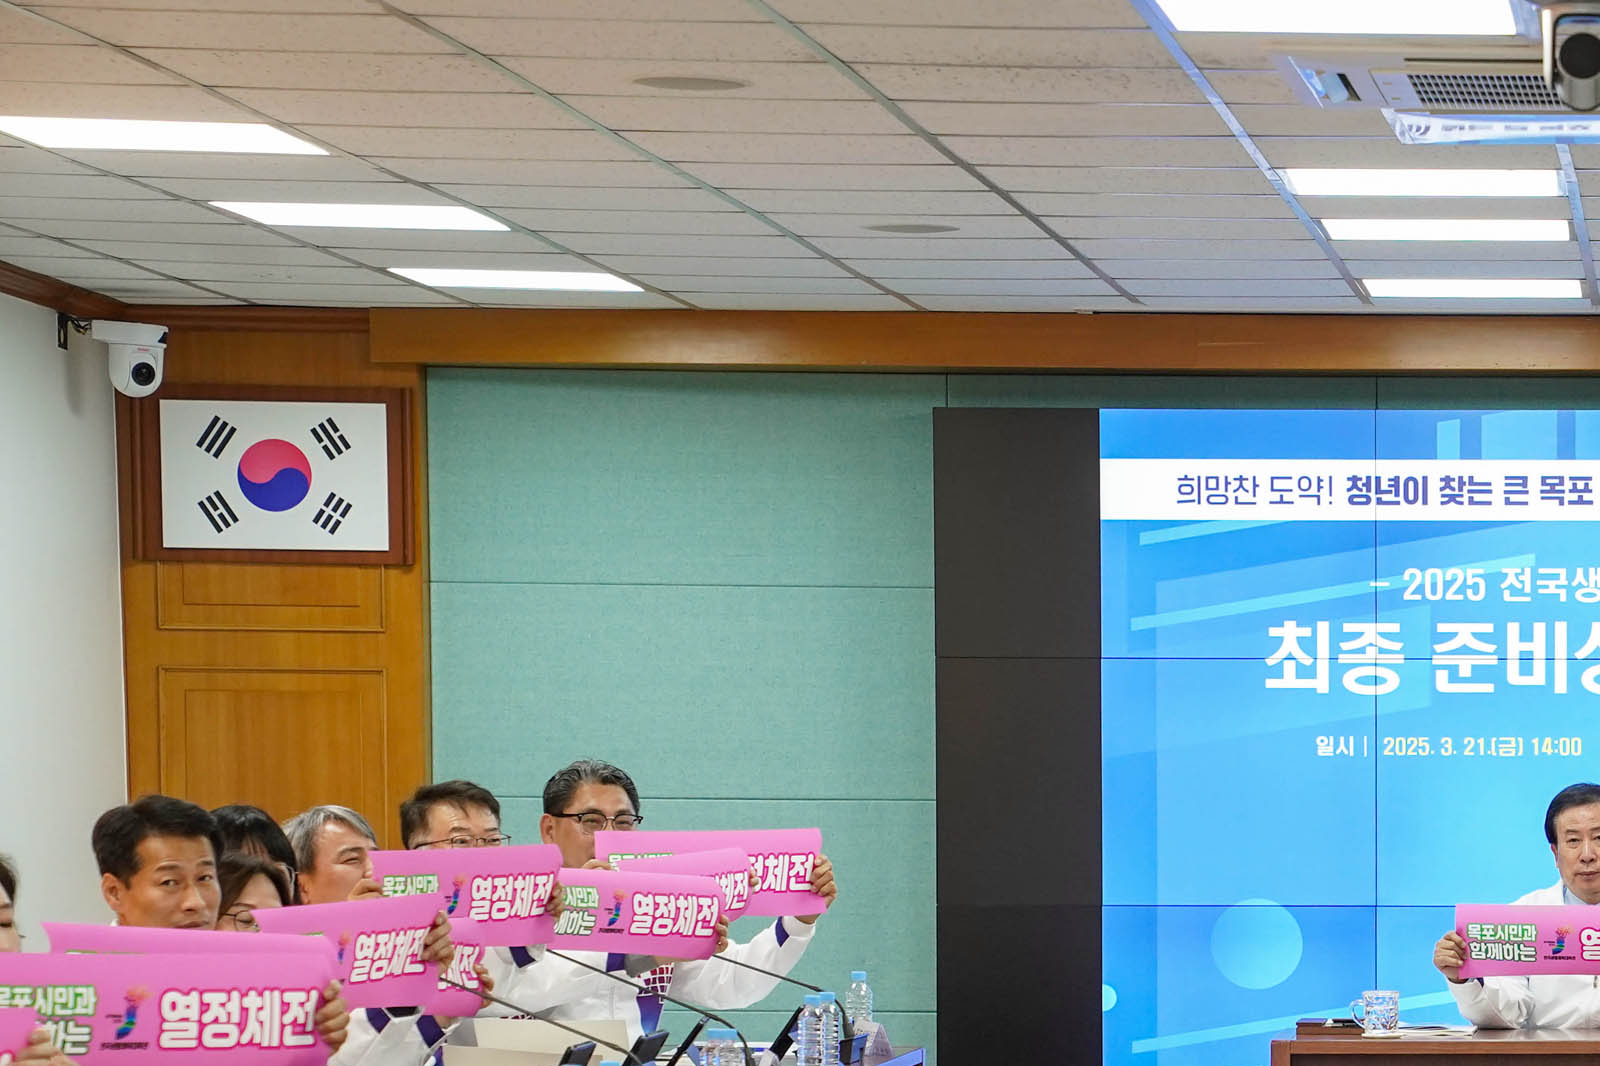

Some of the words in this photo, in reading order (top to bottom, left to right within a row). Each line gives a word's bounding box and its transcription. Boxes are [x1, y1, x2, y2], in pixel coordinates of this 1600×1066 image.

[1177, 474, 1259, 505] 희망찬
[1269, 474, 1333, 505] 도약!
[1346, 474, 1429, 506] 청년이
[1439, 475, 1493, 506] 찾는
[1503, 475, 1530, 506] 큰
[1539, 475, 1594, 506] 목포
[1403, 567, 1486, 601] 2025
[1264, 620, 1405, 696] 최종
[1316, 735, 1354, 757] 일시
[1383, 736, 1434, 756] 2025.
[1440, 736, 1457, 756] 3.
[1531, 736, 1582, 756] 14:00
[469, 872, 555, 921] 열정체전
[629, 891, 720, 937] 열정체전
[1466, 923, 1537, 943] 목포시민과
[1469, 942, 1537, 962] 함께하는
[349, 925, 432, 984] 열정체전
[158, 987, 319, 1050] 열정체전
